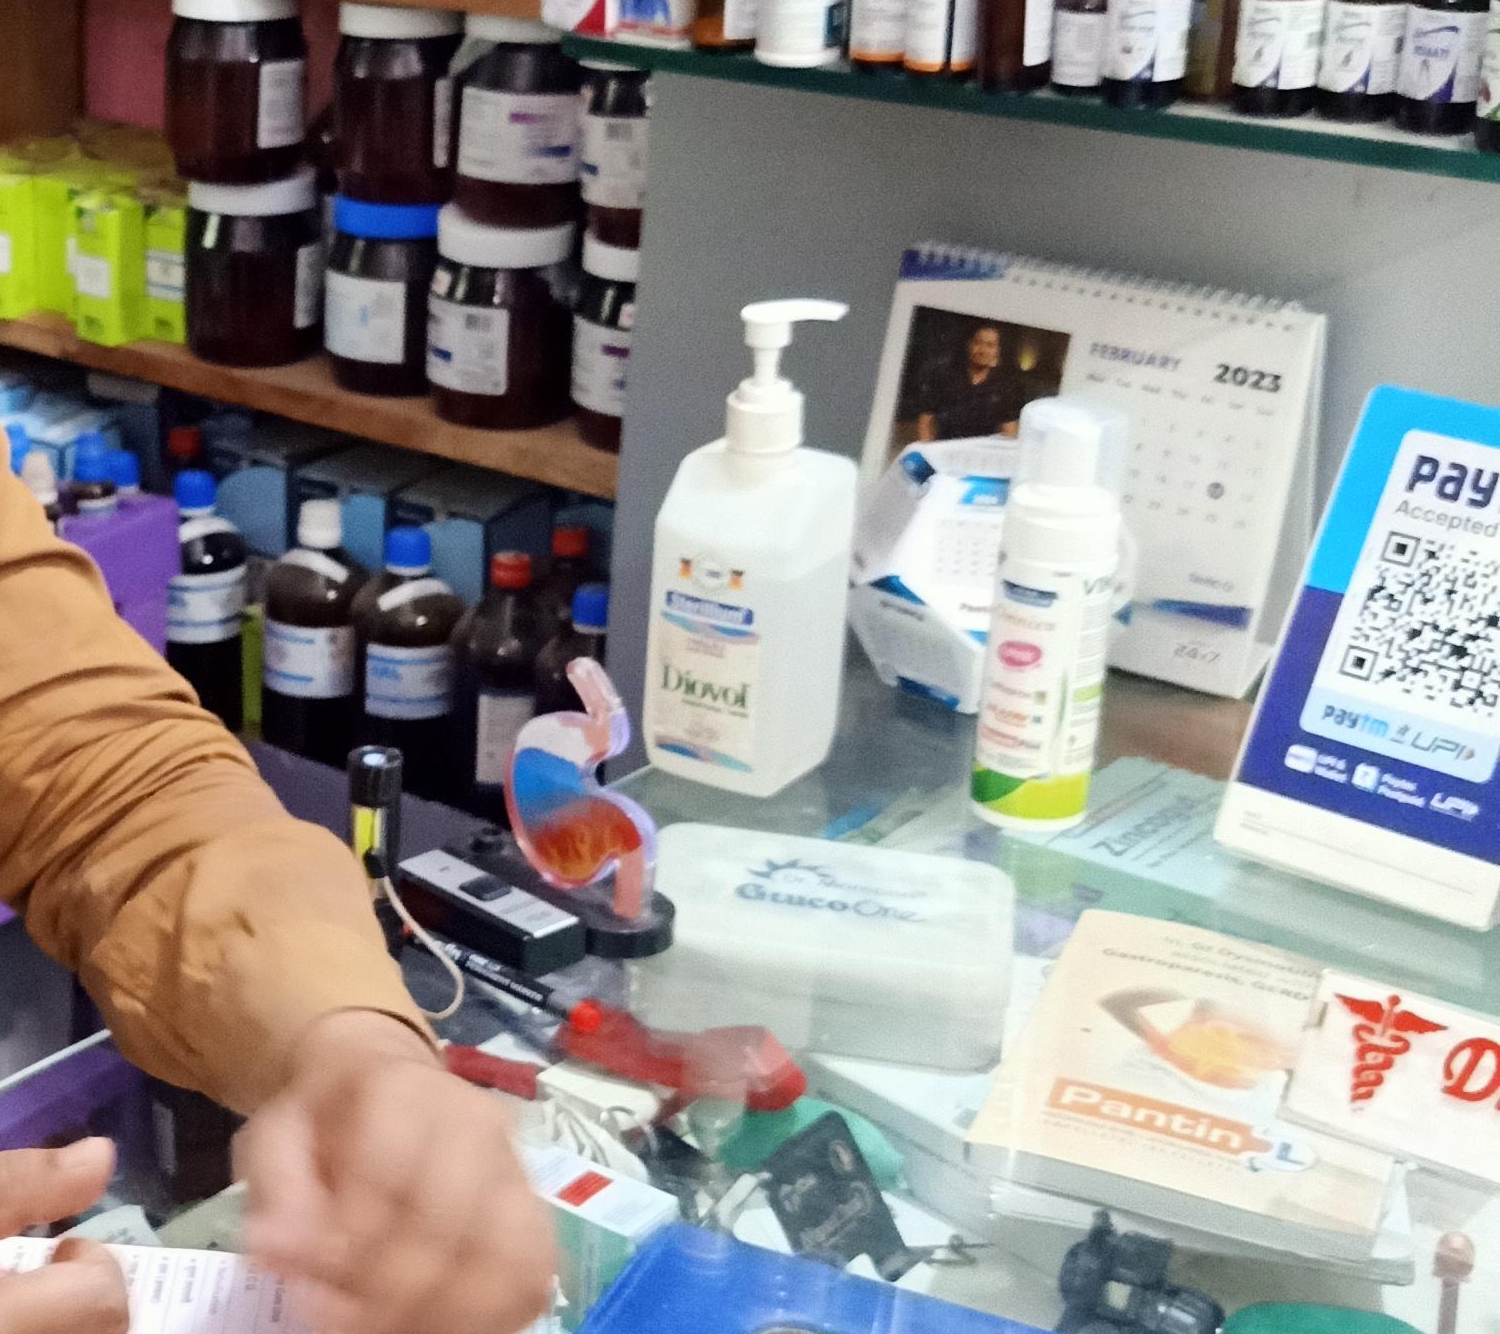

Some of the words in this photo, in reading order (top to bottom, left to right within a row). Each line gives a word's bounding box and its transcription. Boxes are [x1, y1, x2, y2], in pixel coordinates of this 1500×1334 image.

[1089, 341, 1181, 372] FEBRUARY
[1214, 362, 1284, 394] 2023
[1395, 499, 1499, 538] Accepted
[1442, 1037, 1500, 1111] D
[1060, 1084, 1244, 1150] Pantin
